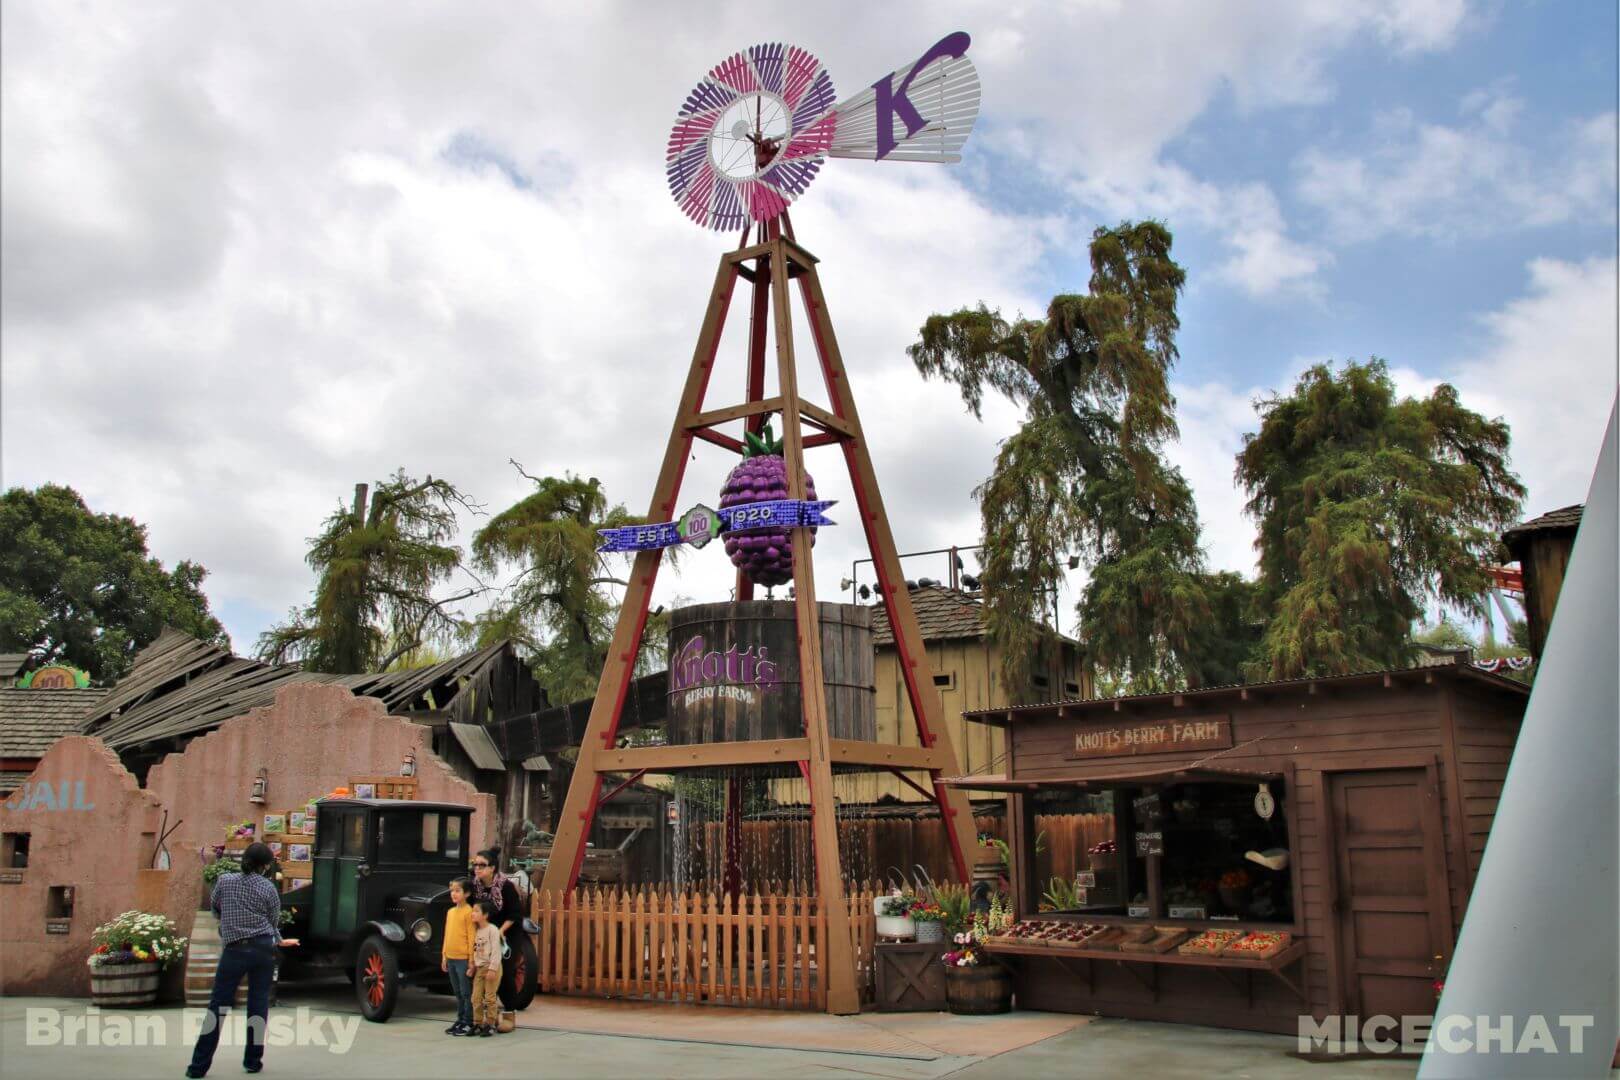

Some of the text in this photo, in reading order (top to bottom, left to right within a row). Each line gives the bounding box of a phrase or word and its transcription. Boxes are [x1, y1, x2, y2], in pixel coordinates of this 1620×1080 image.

[871, 31, 971, 161] K
[689, 517, 707, 535] 100
[730, 506, 772, 524] 1920
[671, 635, 777, 706] Knott's
[685, 685, 717, 709] BERRY
[1075, 721, 1220, 750] KNOTT'S BERRY FARM
[6, 780, 96, 811] JAIL
